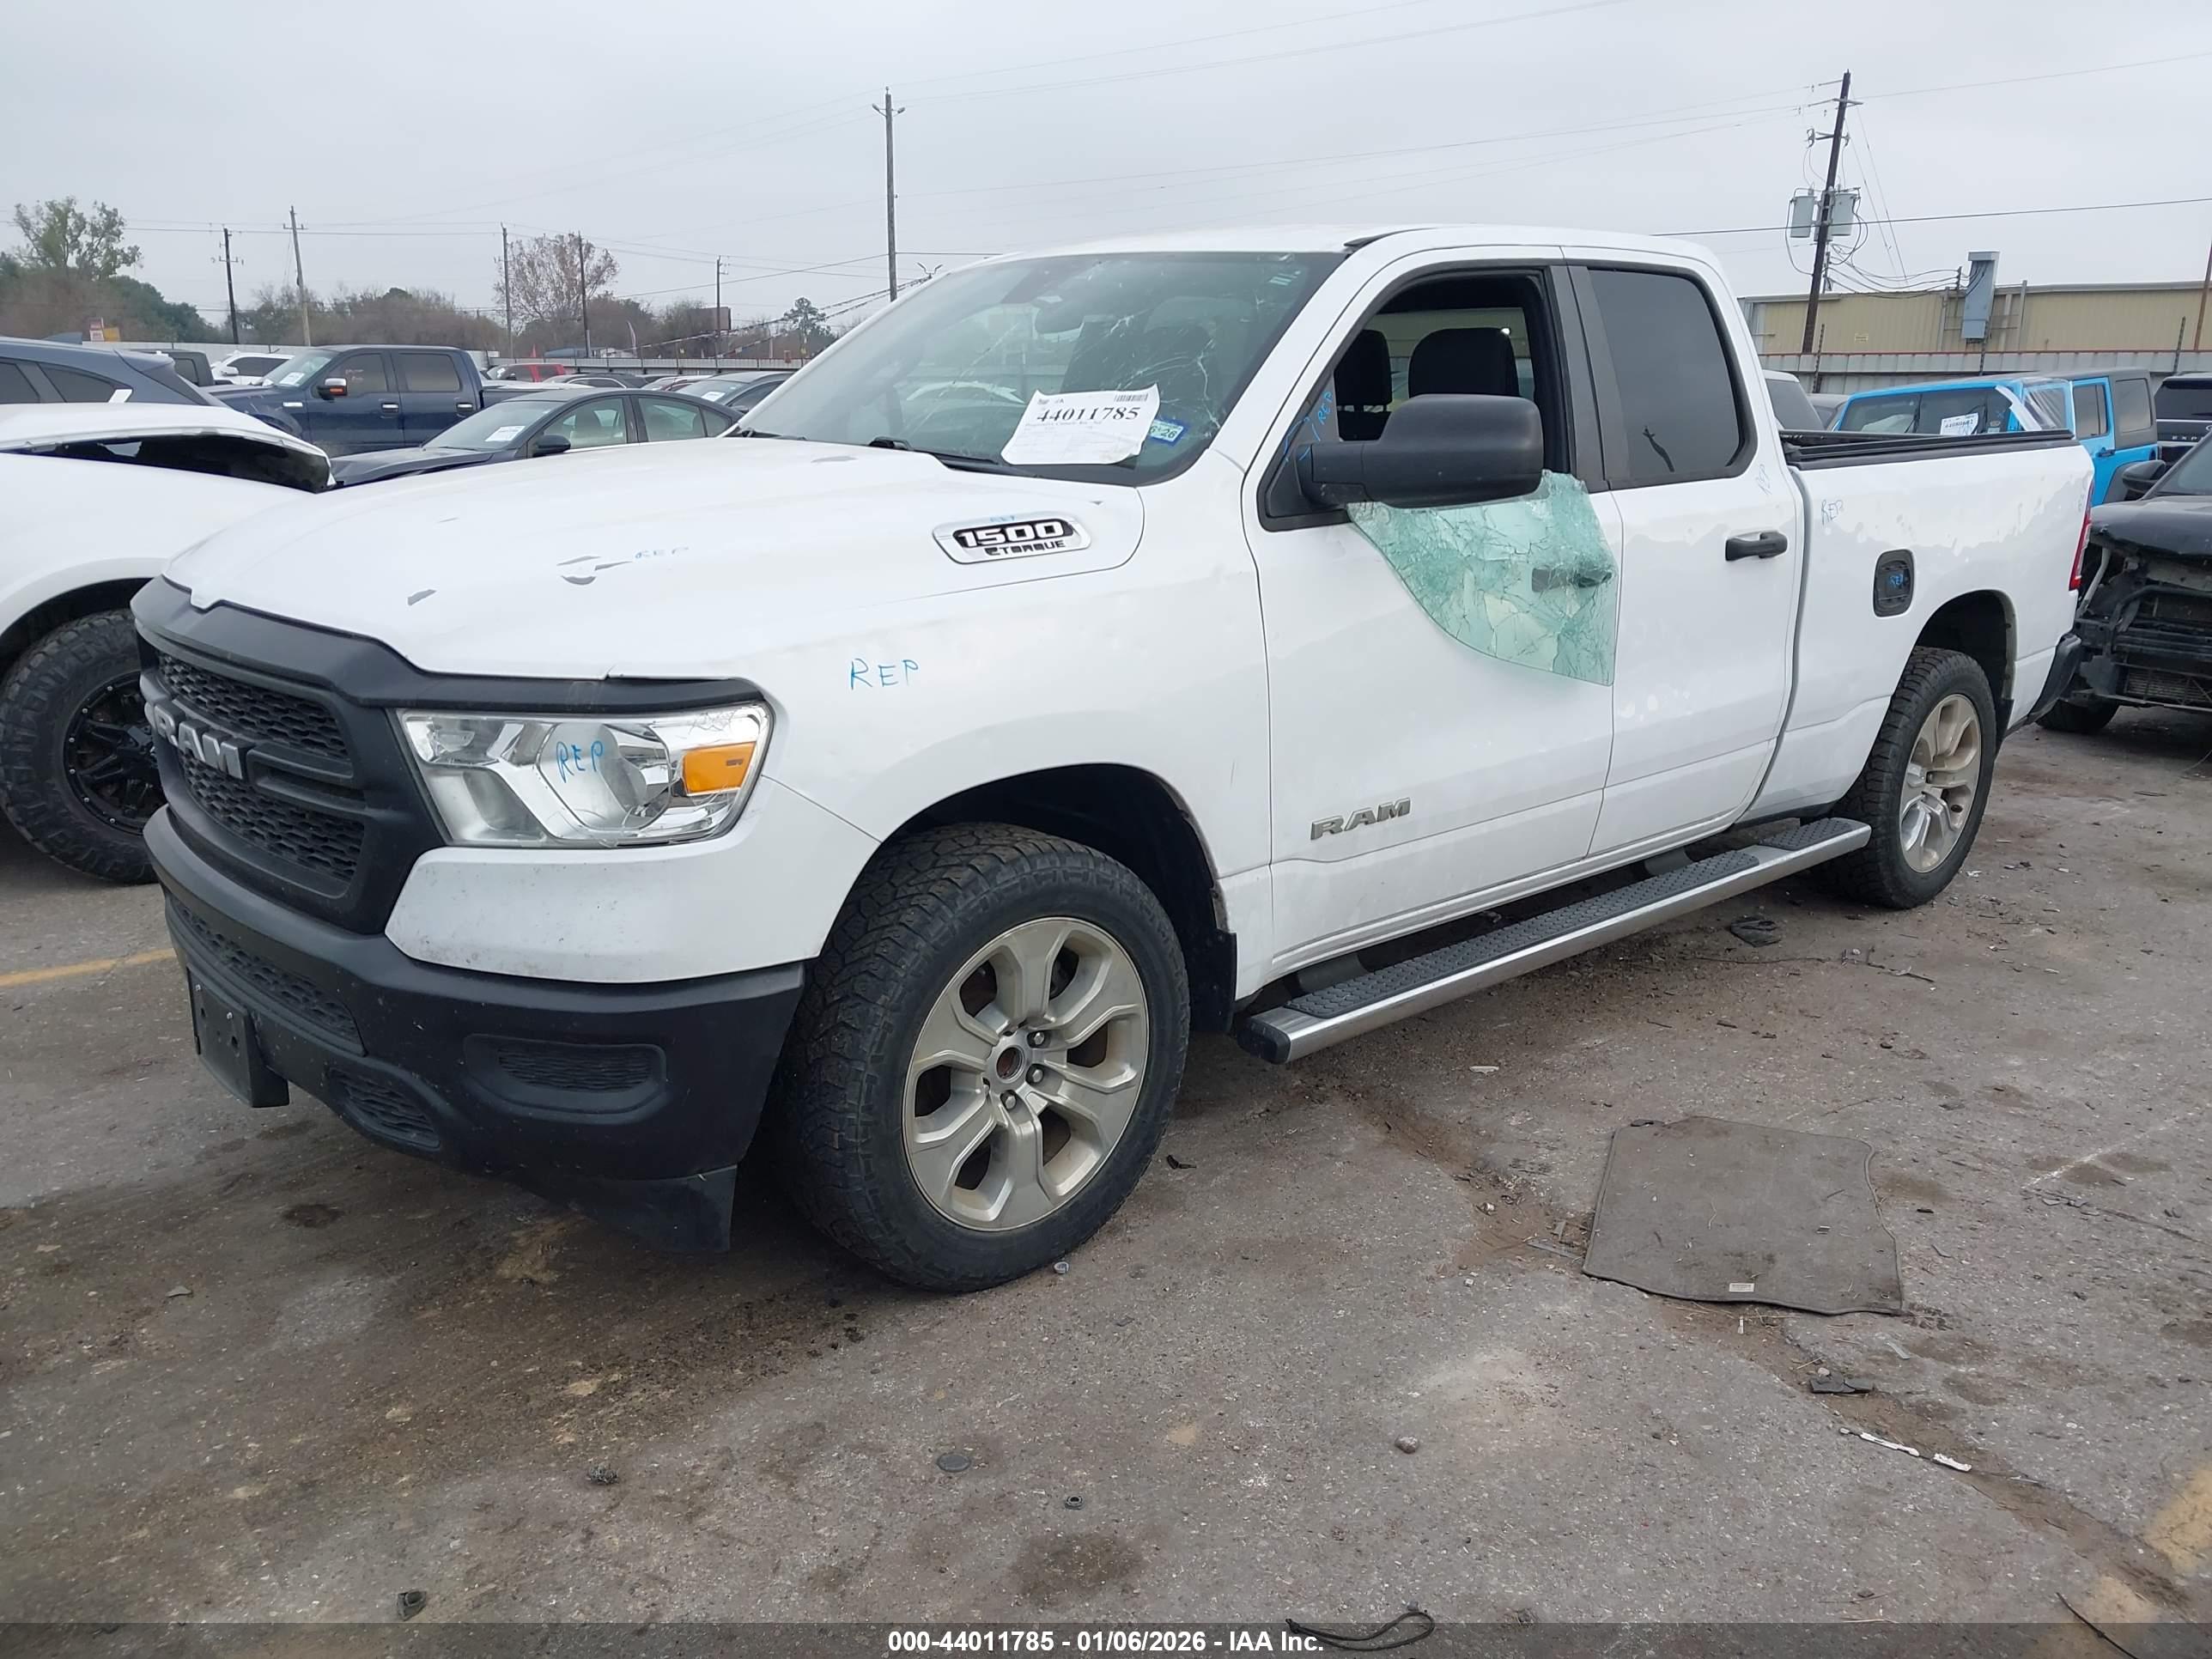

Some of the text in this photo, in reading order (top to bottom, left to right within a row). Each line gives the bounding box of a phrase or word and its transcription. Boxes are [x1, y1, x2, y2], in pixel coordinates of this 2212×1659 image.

[1036, 406, 1141, 422] 44011785
[1820, 499, 1844, 526] REP
[957, 520, 1065, 549] 1500
[850, 658, 919, 690] REP
[154, 704, 243, 780] RAM
[556, 740, 604, 783] REP
[1310, 797, 1411, 841] RAM
